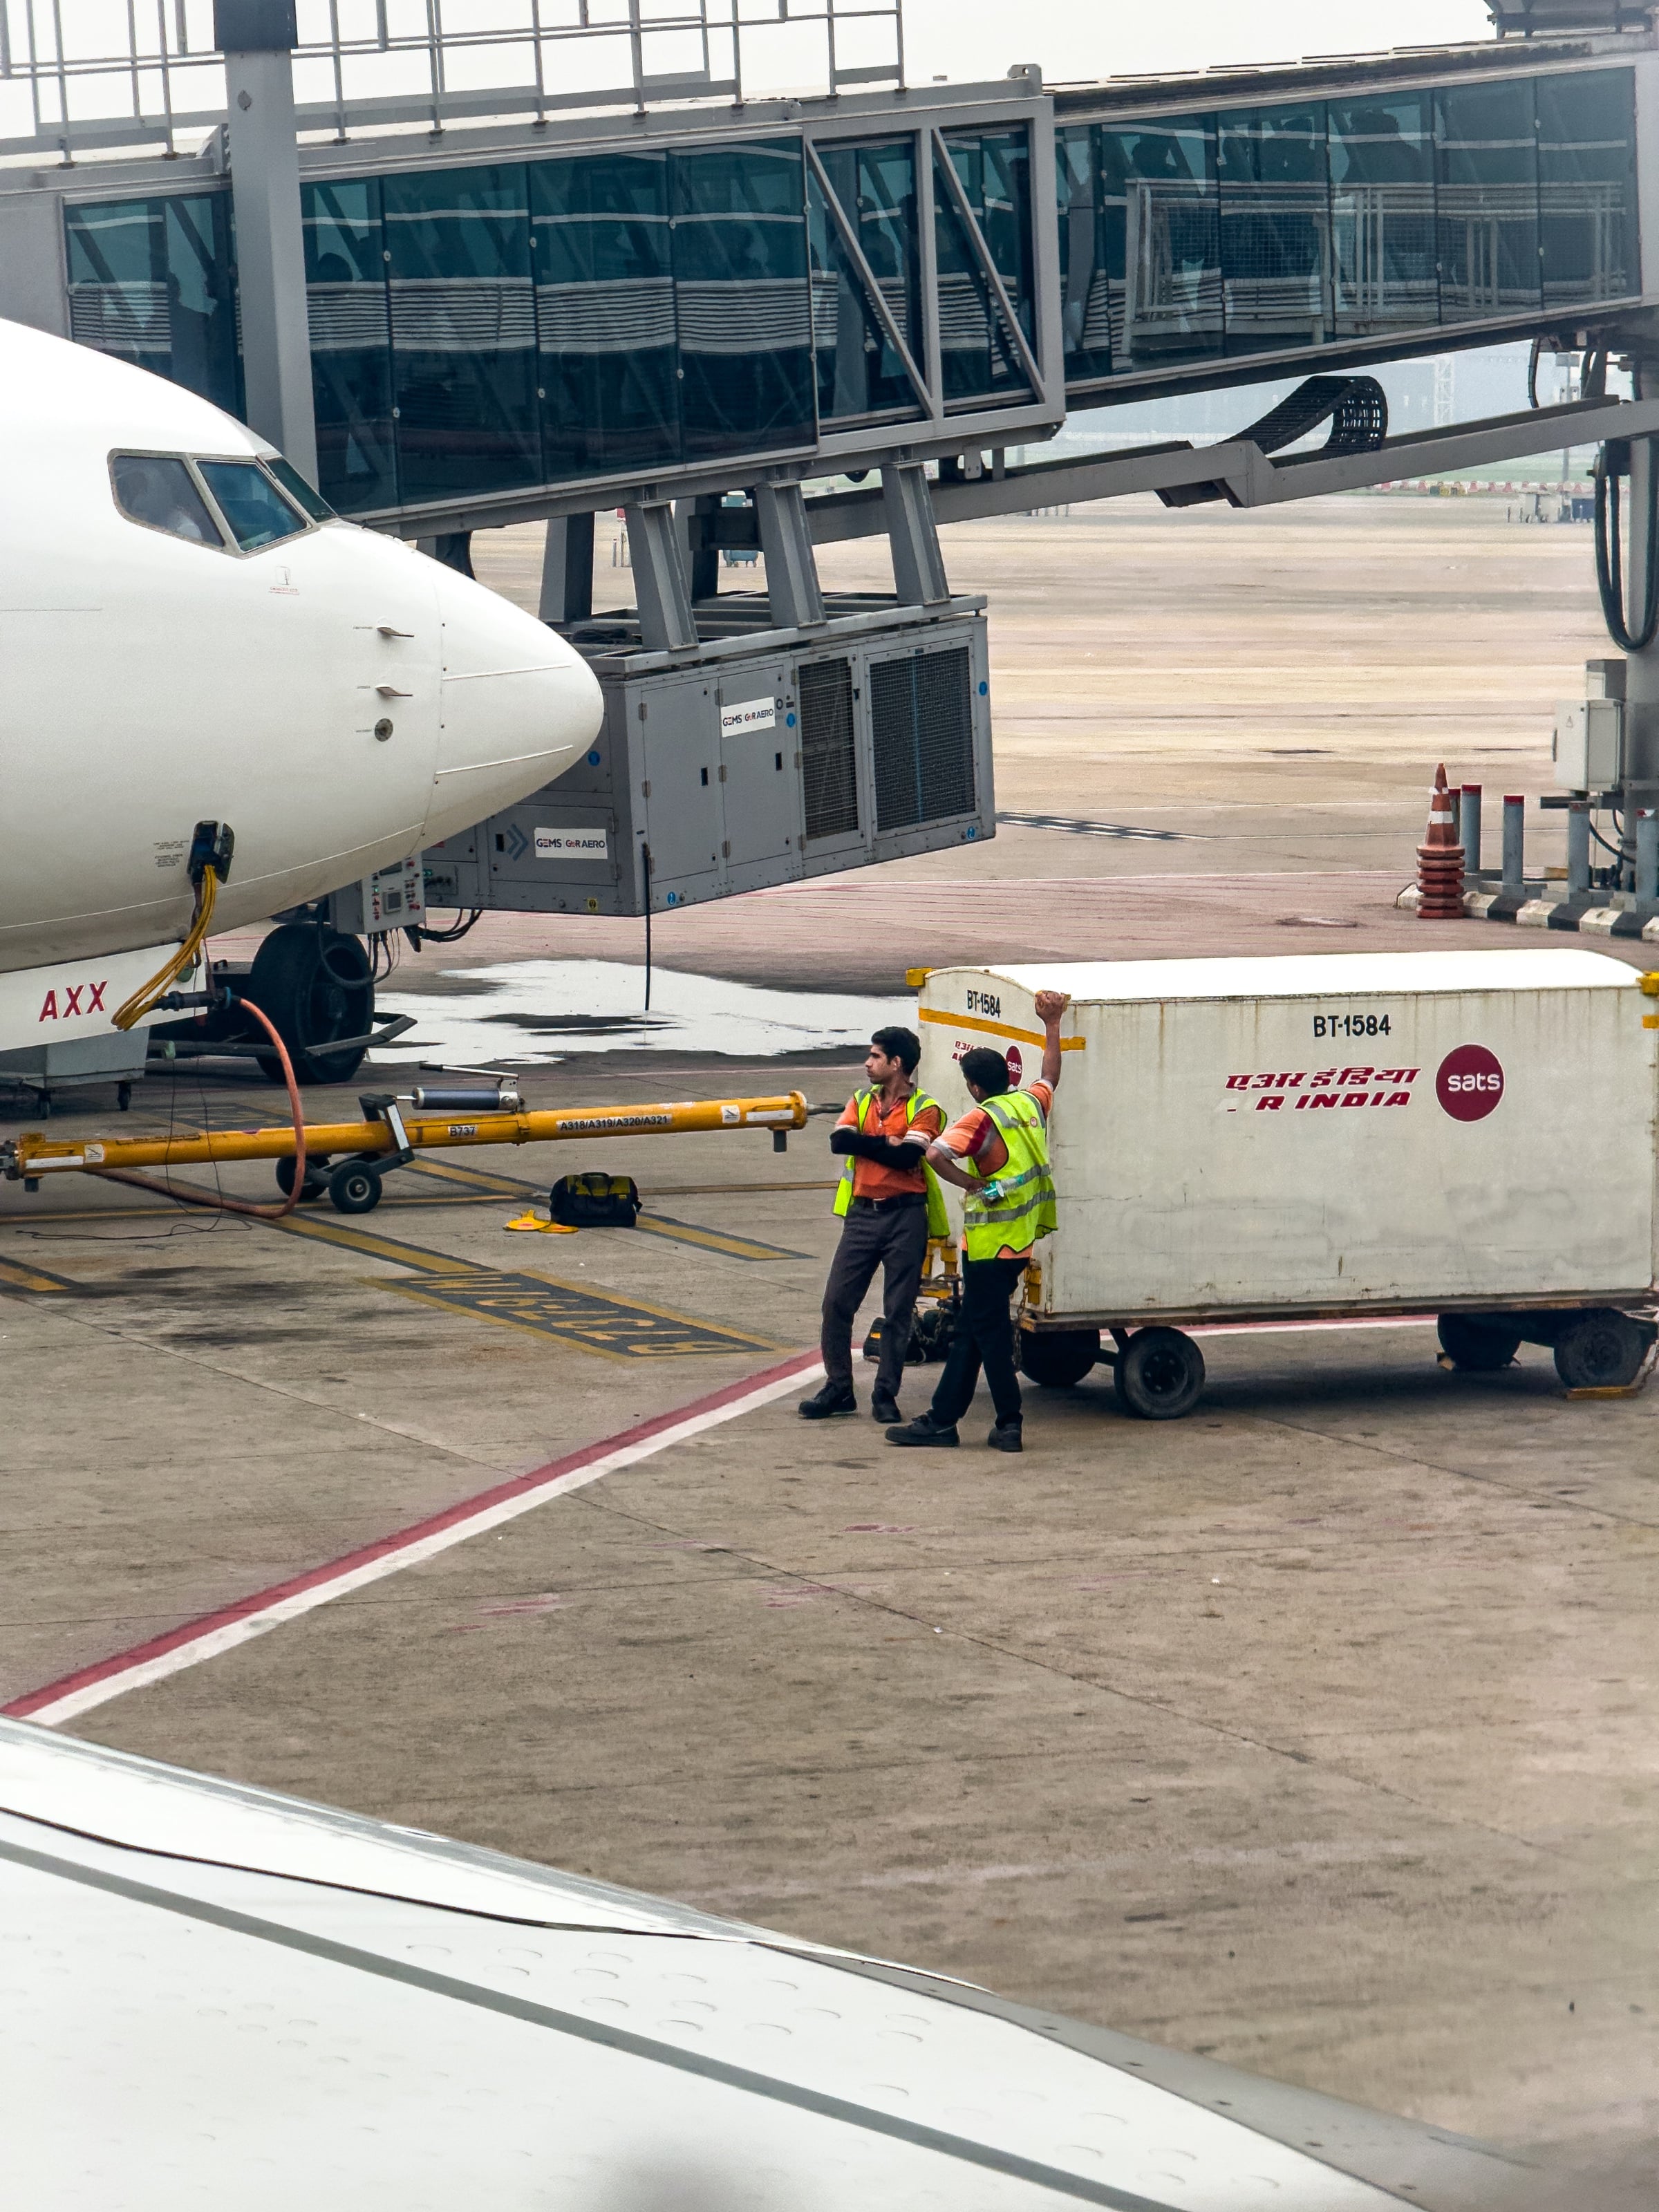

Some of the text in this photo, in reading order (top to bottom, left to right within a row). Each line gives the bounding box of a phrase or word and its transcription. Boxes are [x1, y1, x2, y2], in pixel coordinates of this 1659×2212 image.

[722, 714, 742, 727] GEMS
[756, 709, 774, 719] AERO
[536, 838, 561, 847] GEMS
[581, 840, 605, 848] AERO
[39, 981, 107, 1022] AXX
[967, 990, 1001, 1018] BT-1584
[1313, 1015, 1391, 1037] BT-1584
[1007, 1061, 1022, 1074] sats
[1447, 1072, 1501, 1091] sats
[1294, 1091, 1411, 1109] INDIA
[450, 1127, 476, 1136] B737
[561, 1116, 667, 1131] A318/A319/A320/A321
